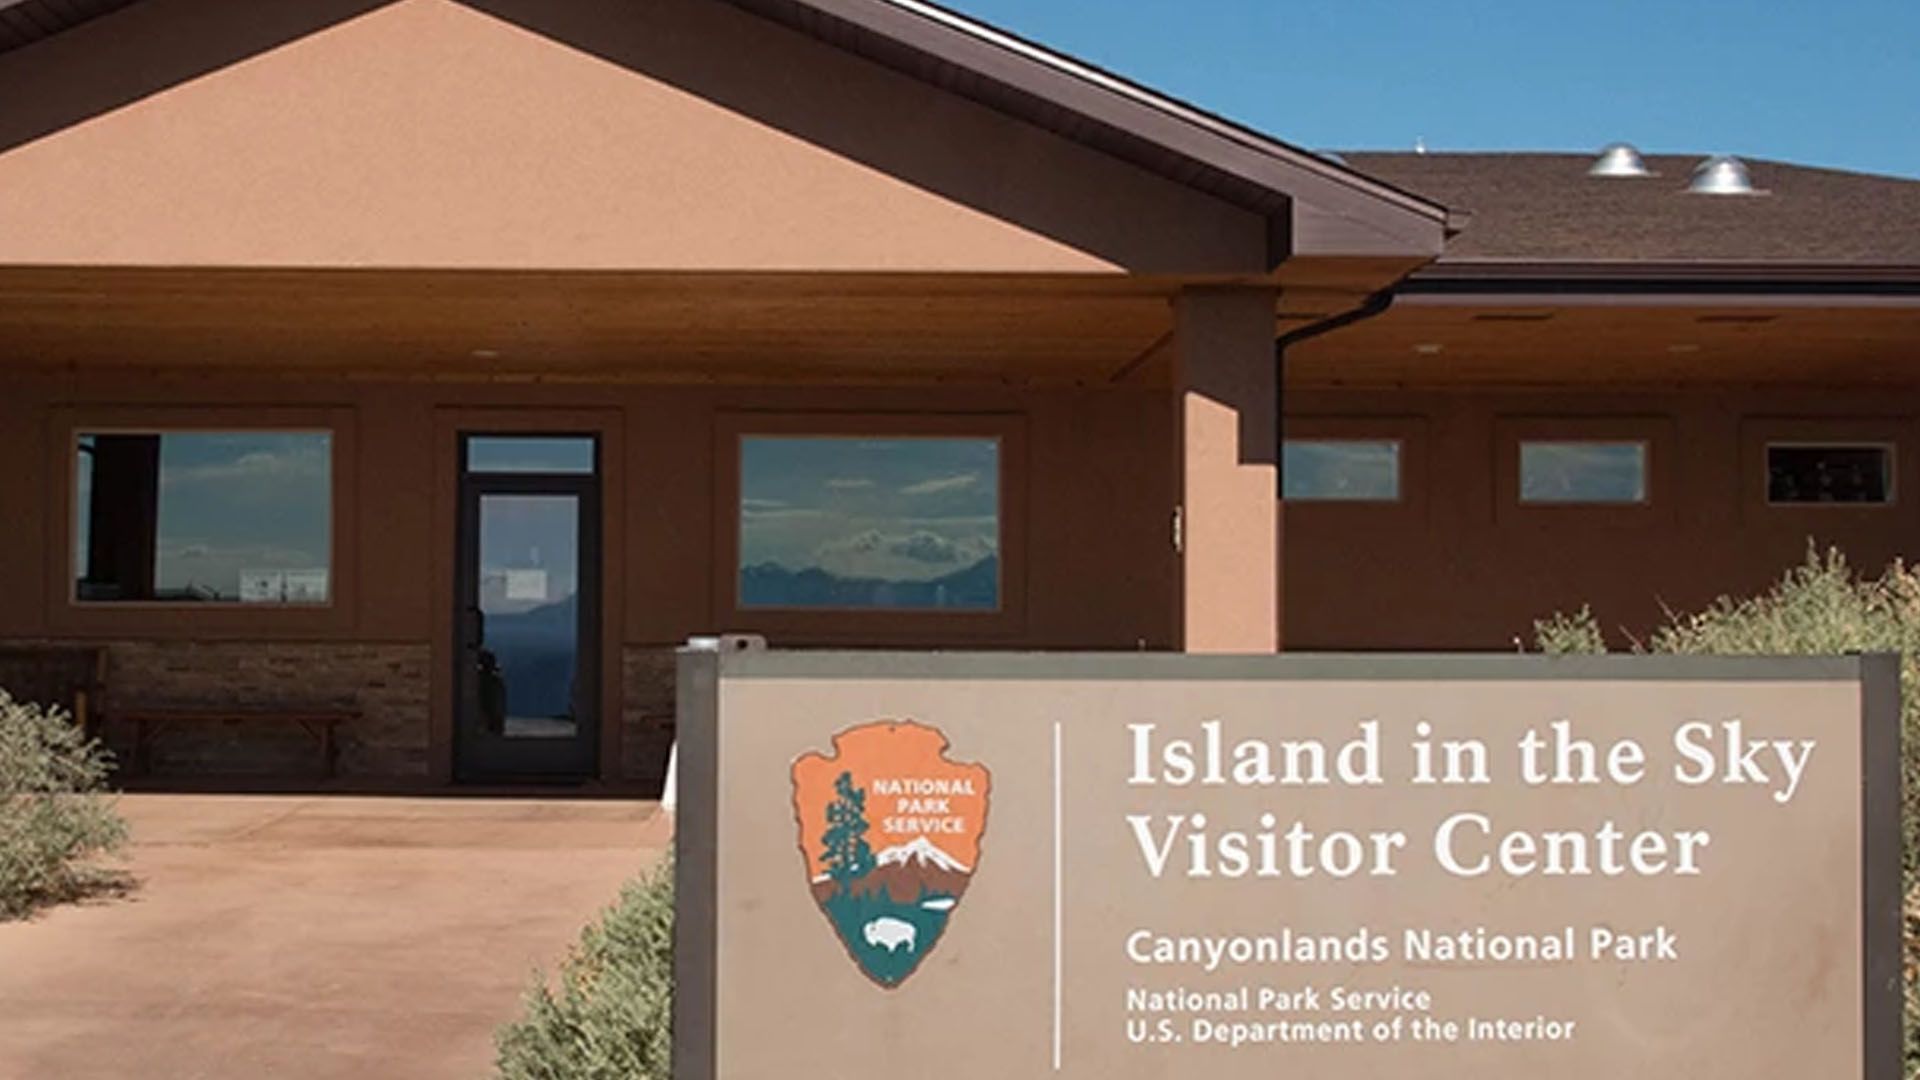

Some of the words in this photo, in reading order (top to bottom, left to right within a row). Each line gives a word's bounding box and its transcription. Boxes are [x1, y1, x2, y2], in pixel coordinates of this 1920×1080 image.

[1126, 720, 1384, 786] Island
[1412, 721, 1492, 785] in
[1518, 720, 1646, 785] the
[1674, 720, 1816, 804] Sky
[873, 779, 975, 796] NATIONAL
[897, 798, 949, 814] PARK
[883, 817, 965, 834] SERVICE
[1126, 812, 1407, 878] Visitor
[1433, 812, 1711, 877] Center
[1126, 927, 1390, 972] Canyonlands
[1404, 926, 1575, 962] National
[1590, 926, 1678, 961] Park
[1126, 986, 1249, 1012] National
[1258, 986, 1321, 1012] Park
[1330, 986, 1432, 1012] Service
[1126, 1018, 1182, 1044] U.S.
[1193, 1018, 1364, 1048] Department
[1372, 1016, 1403, 1042] of
[1411, 1017, 1459, 1041] the
[1468, 1016, 1576, 1041] Interior
